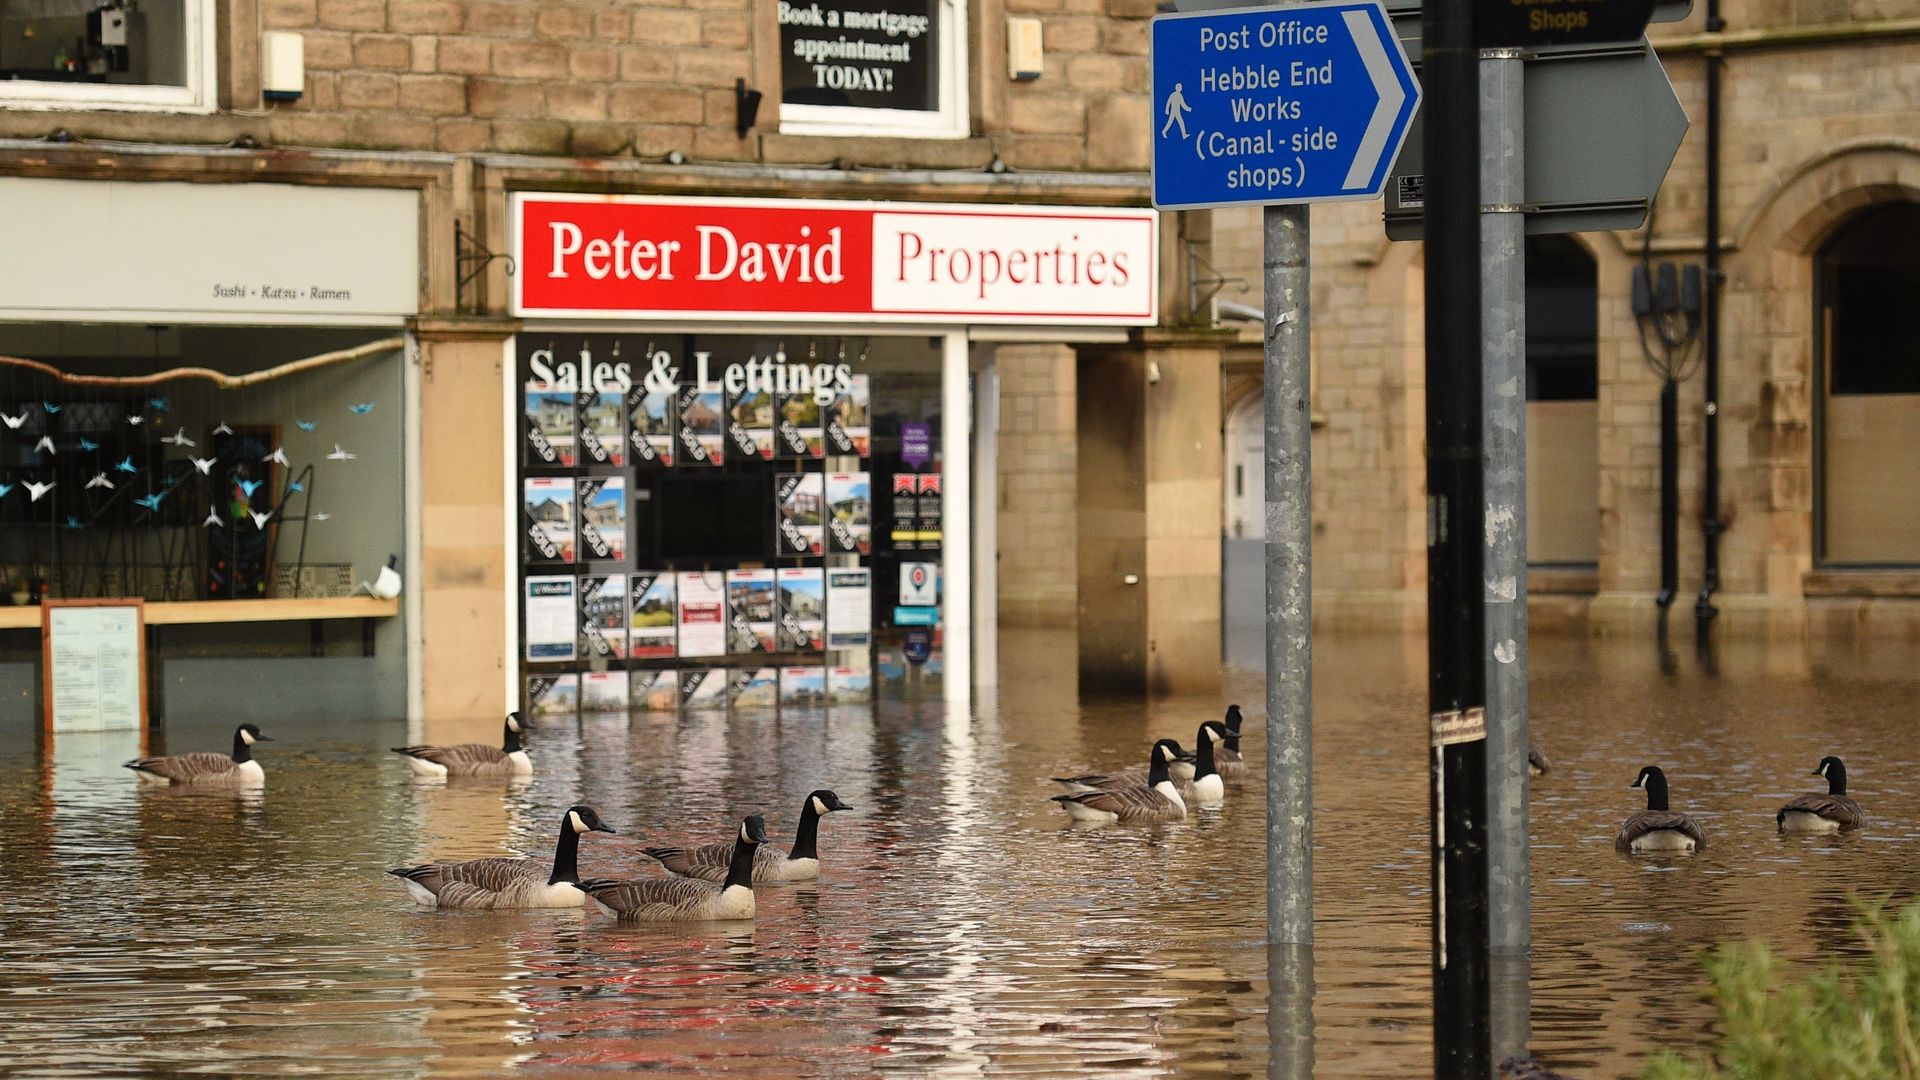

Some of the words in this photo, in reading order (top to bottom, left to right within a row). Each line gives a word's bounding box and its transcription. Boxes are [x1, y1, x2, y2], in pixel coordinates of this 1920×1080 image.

[778, 1, 825, 27] Book
[827, 10, 840, 28] a
[843, 10, 929, 38] mortgage
[1200, 25, 1250, 52] Post
[1259, 20, 1329, 49] Office
[1529, 9, 1589, 32] Shops
[793, 35, 912, 63] appointment
[812, 64, 894, 92] TODAY!
[1200, 63, 1280, 93] Hebble
[1290, 59, 1333, 87] End
[1231, 95, 1302, 123] Works
[1226, 156, 1306, 191] shops)
[548, 221, 682, 282] Peter
[695, 225, 845, 285] David
[896, 229, 1130, 299] Properties
[212, 283, 246, 299] Sushi
[261, 284, 297, 300] Katsu
[309, 285, 351, 301] Ramen
[529, 349, 632, 395] Sales
[644, 350, 682, 396] &
[694, 350, 853, 407] Lettings
[528, 427, 556, 462] SOLD
[580, 426, 607, 462] SOLD
[630, 429, 655, 461] SOLD
[680, 426, 706, 461] SOLD
[729, 421, 756, 456] SOLD
[779, 419, 806, 454] SOLD
[828, 421, 852, 451] SOLD
[528, 524, 557, 559] SOLD
[581, 522, 609, 558] SOLD
[780, 517, 807, 552] SOLD
[829, 517, 855, 551] SOLD
